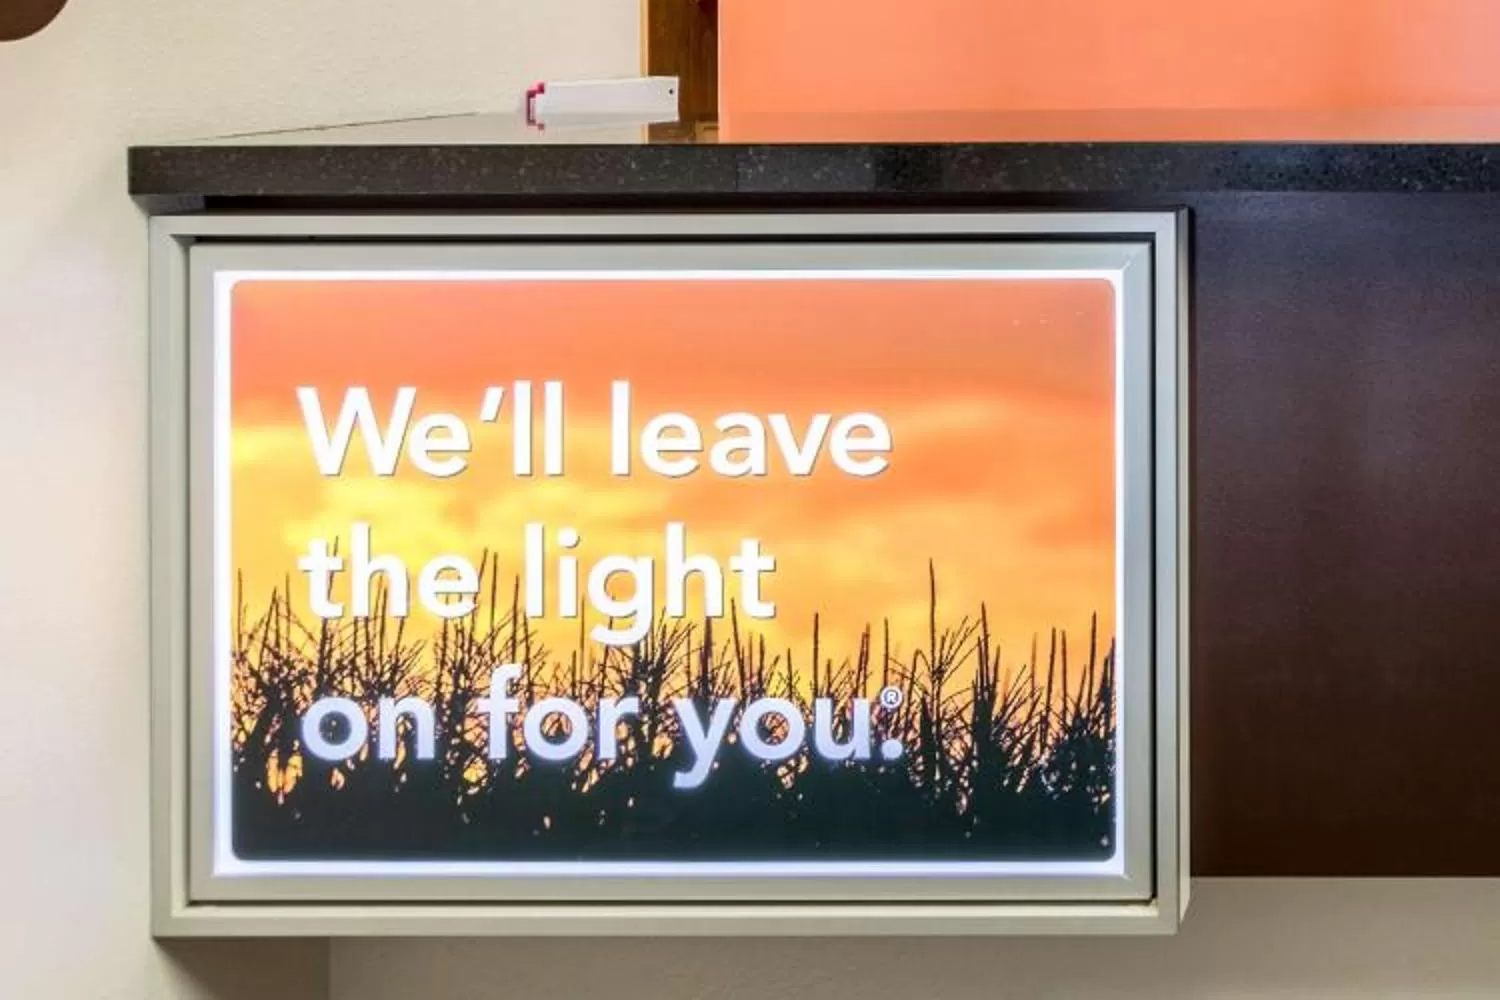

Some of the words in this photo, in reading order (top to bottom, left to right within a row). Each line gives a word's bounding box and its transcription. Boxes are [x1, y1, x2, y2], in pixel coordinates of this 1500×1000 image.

[297, 380, 563, 477] We’ll
[611, 381, 891, 477] leave
[297, 521, 480, 619] the
[524, 520, 776, 647] light
[302, 691, 437, 760] on
[473, 662, 640, 760] for
